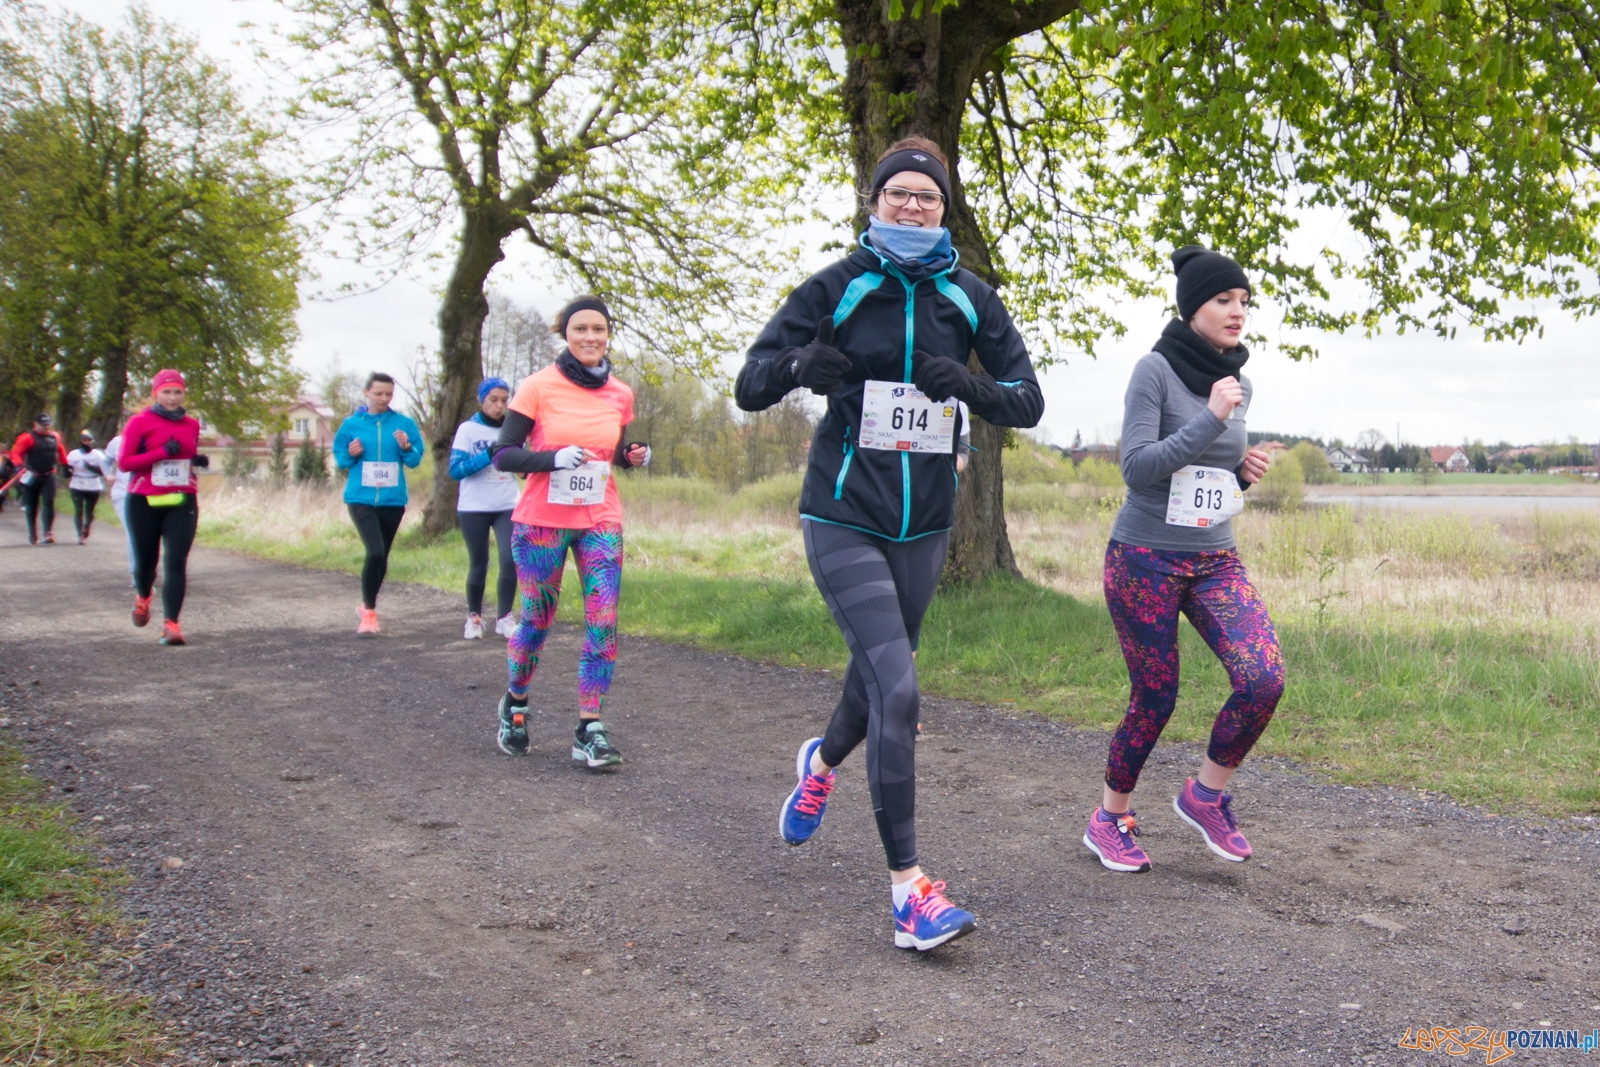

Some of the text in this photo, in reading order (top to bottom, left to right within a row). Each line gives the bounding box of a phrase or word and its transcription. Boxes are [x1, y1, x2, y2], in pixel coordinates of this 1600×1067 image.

[891, 406, 928, 431] 614
[877, 431, 893, 439] 5KM
[163, 468, 179, 478] 544
[373, 469, 389, 479] 694
[569, 475, 594, 492] 664
[1193, 487, 1223, 510] 613
